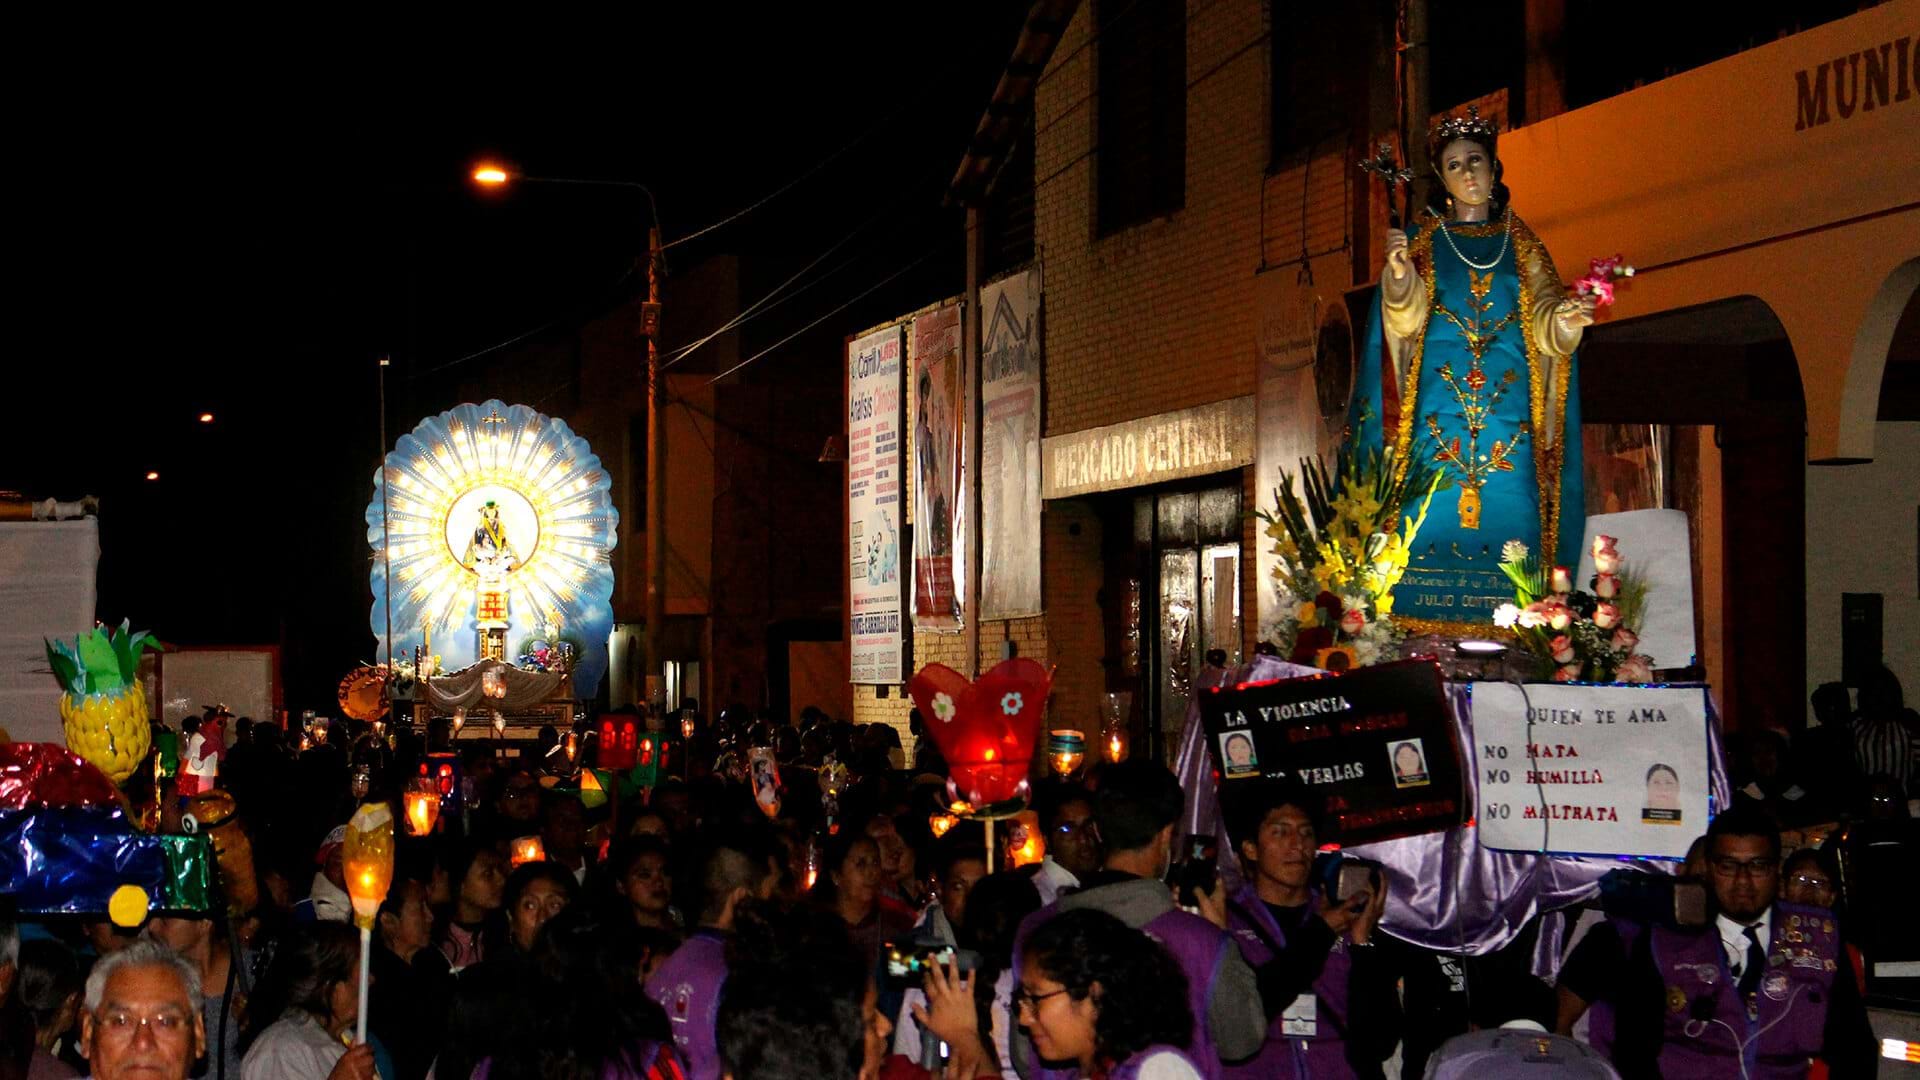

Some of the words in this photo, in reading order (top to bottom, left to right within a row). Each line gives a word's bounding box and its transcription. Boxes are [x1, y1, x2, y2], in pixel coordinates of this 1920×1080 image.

[1054, 432, 1136, 489] MERCADO
[1143, 410, 1232, 473] CENTRAL
[1414, 594, 1455, 607] JULIO
[1224, 710, 1247, 727] LA
[1258, 696, 1351, 723] VIOLENCIA
[1526, 708, 1582, 726] QUIEN
[1594, 710, 1617, 724] TE
[1628, 708, 1668, 723] AMA
[1484, 745, 1509, 760] NO
[1526, 744, 1579, 759] MATA
[1298, 762, 1365, 785] VERLAS
[1486, 769, 1511, 785] NO
[1526, 769, 1604, 785] HUMILLA
[1485, 803, 1511, 821] NO
[1523, 804, 1619, 823] MALTRATA
